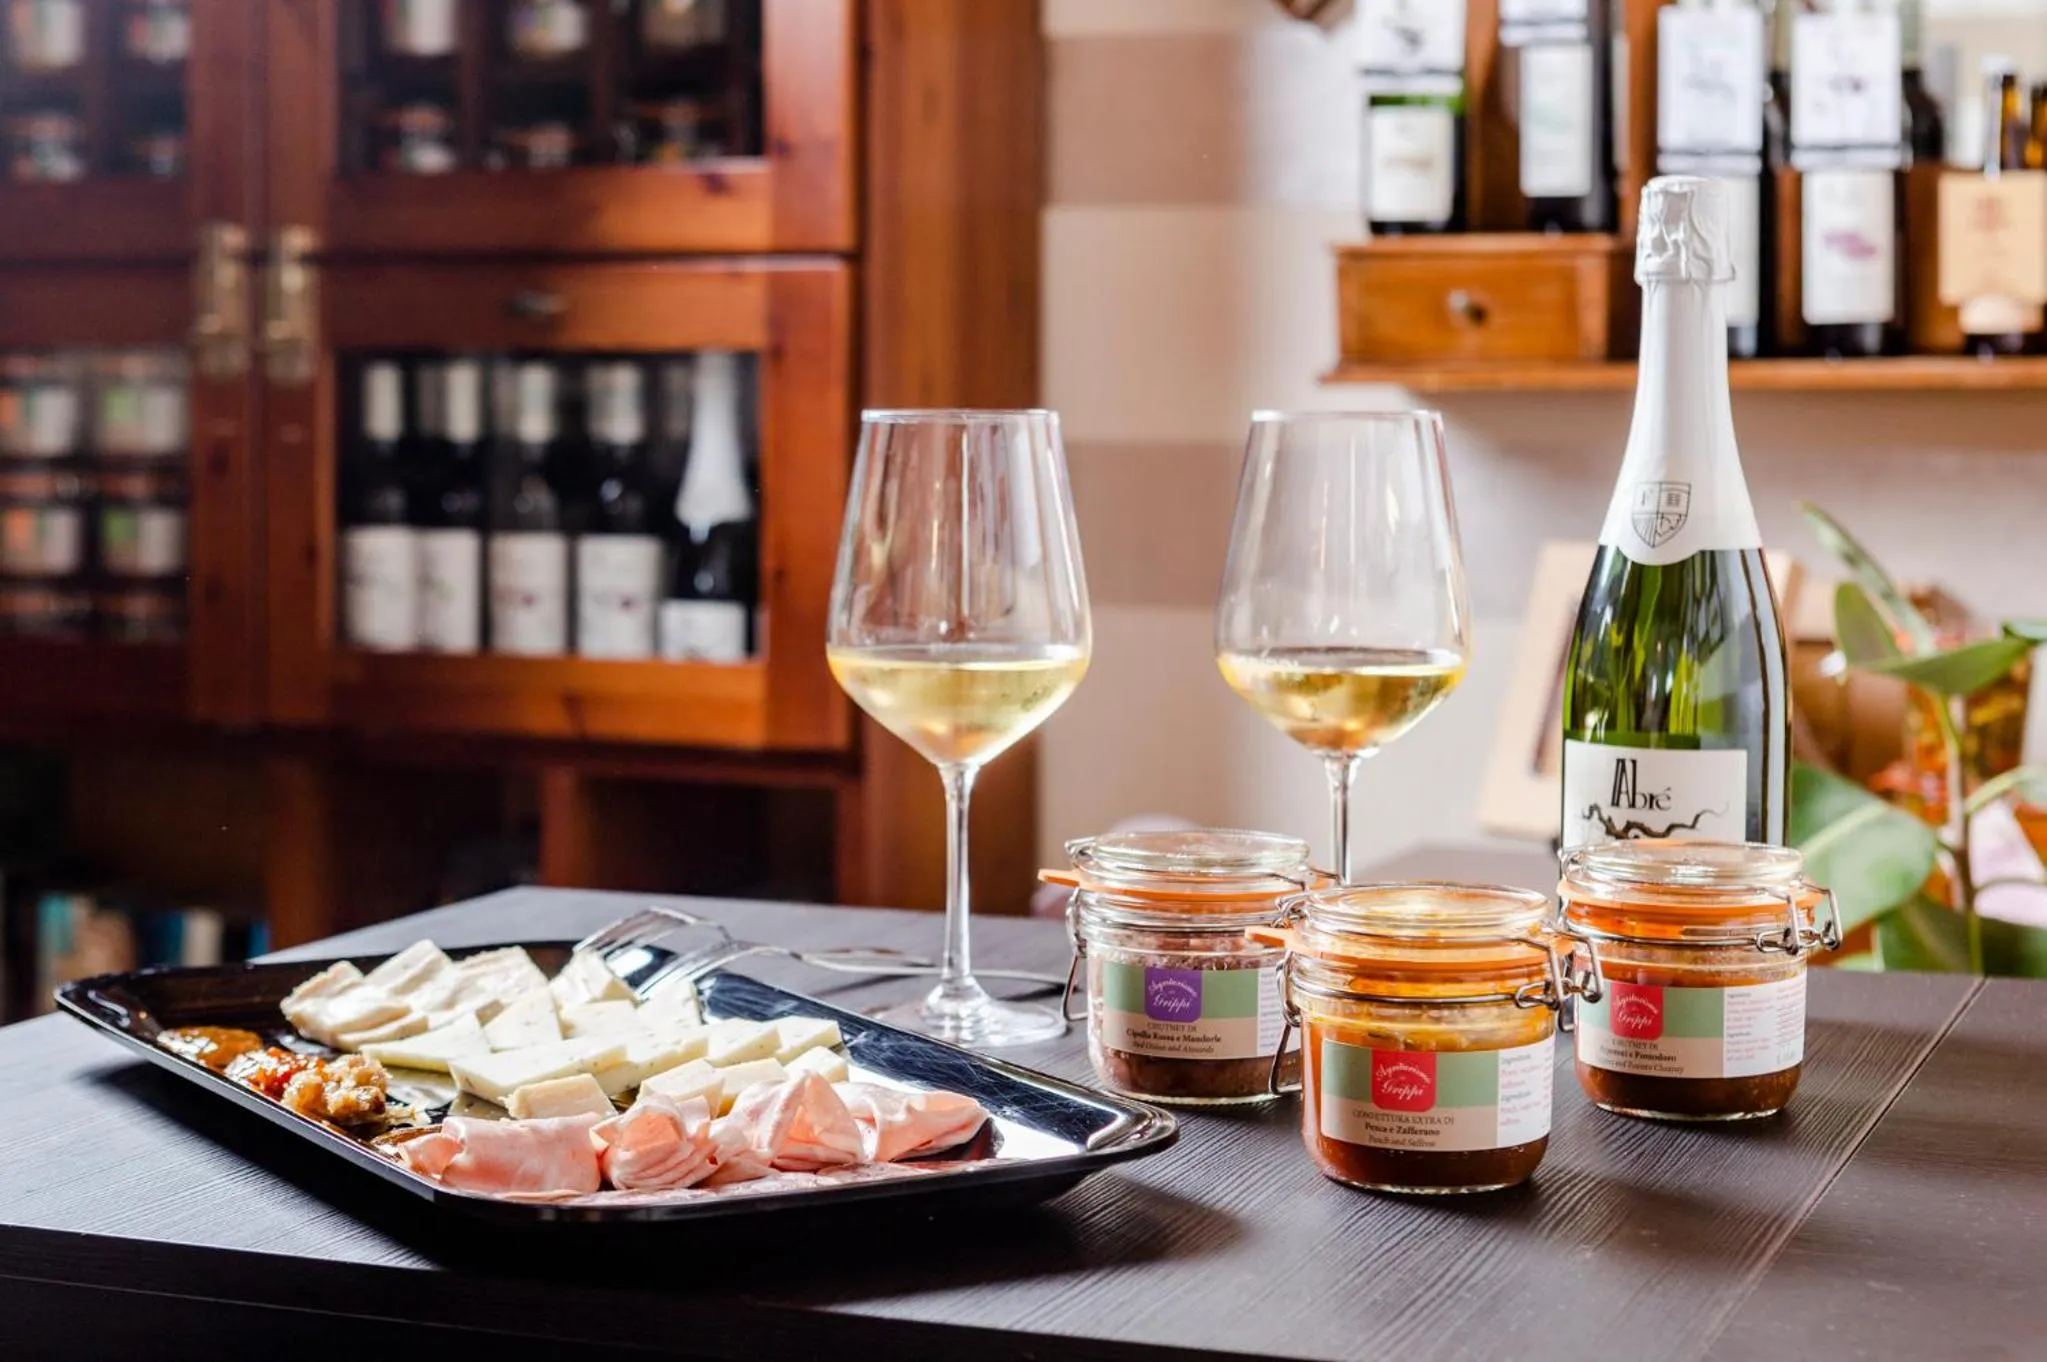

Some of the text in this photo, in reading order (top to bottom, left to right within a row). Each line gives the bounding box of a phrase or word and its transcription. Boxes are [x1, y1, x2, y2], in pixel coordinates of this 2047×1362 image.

[1182, 1034, 1221, 1043] Mandorle
[1365, 1121, 1388, 1132] Pesca
[1395, 1125, 1441, 1136] Zafferano
